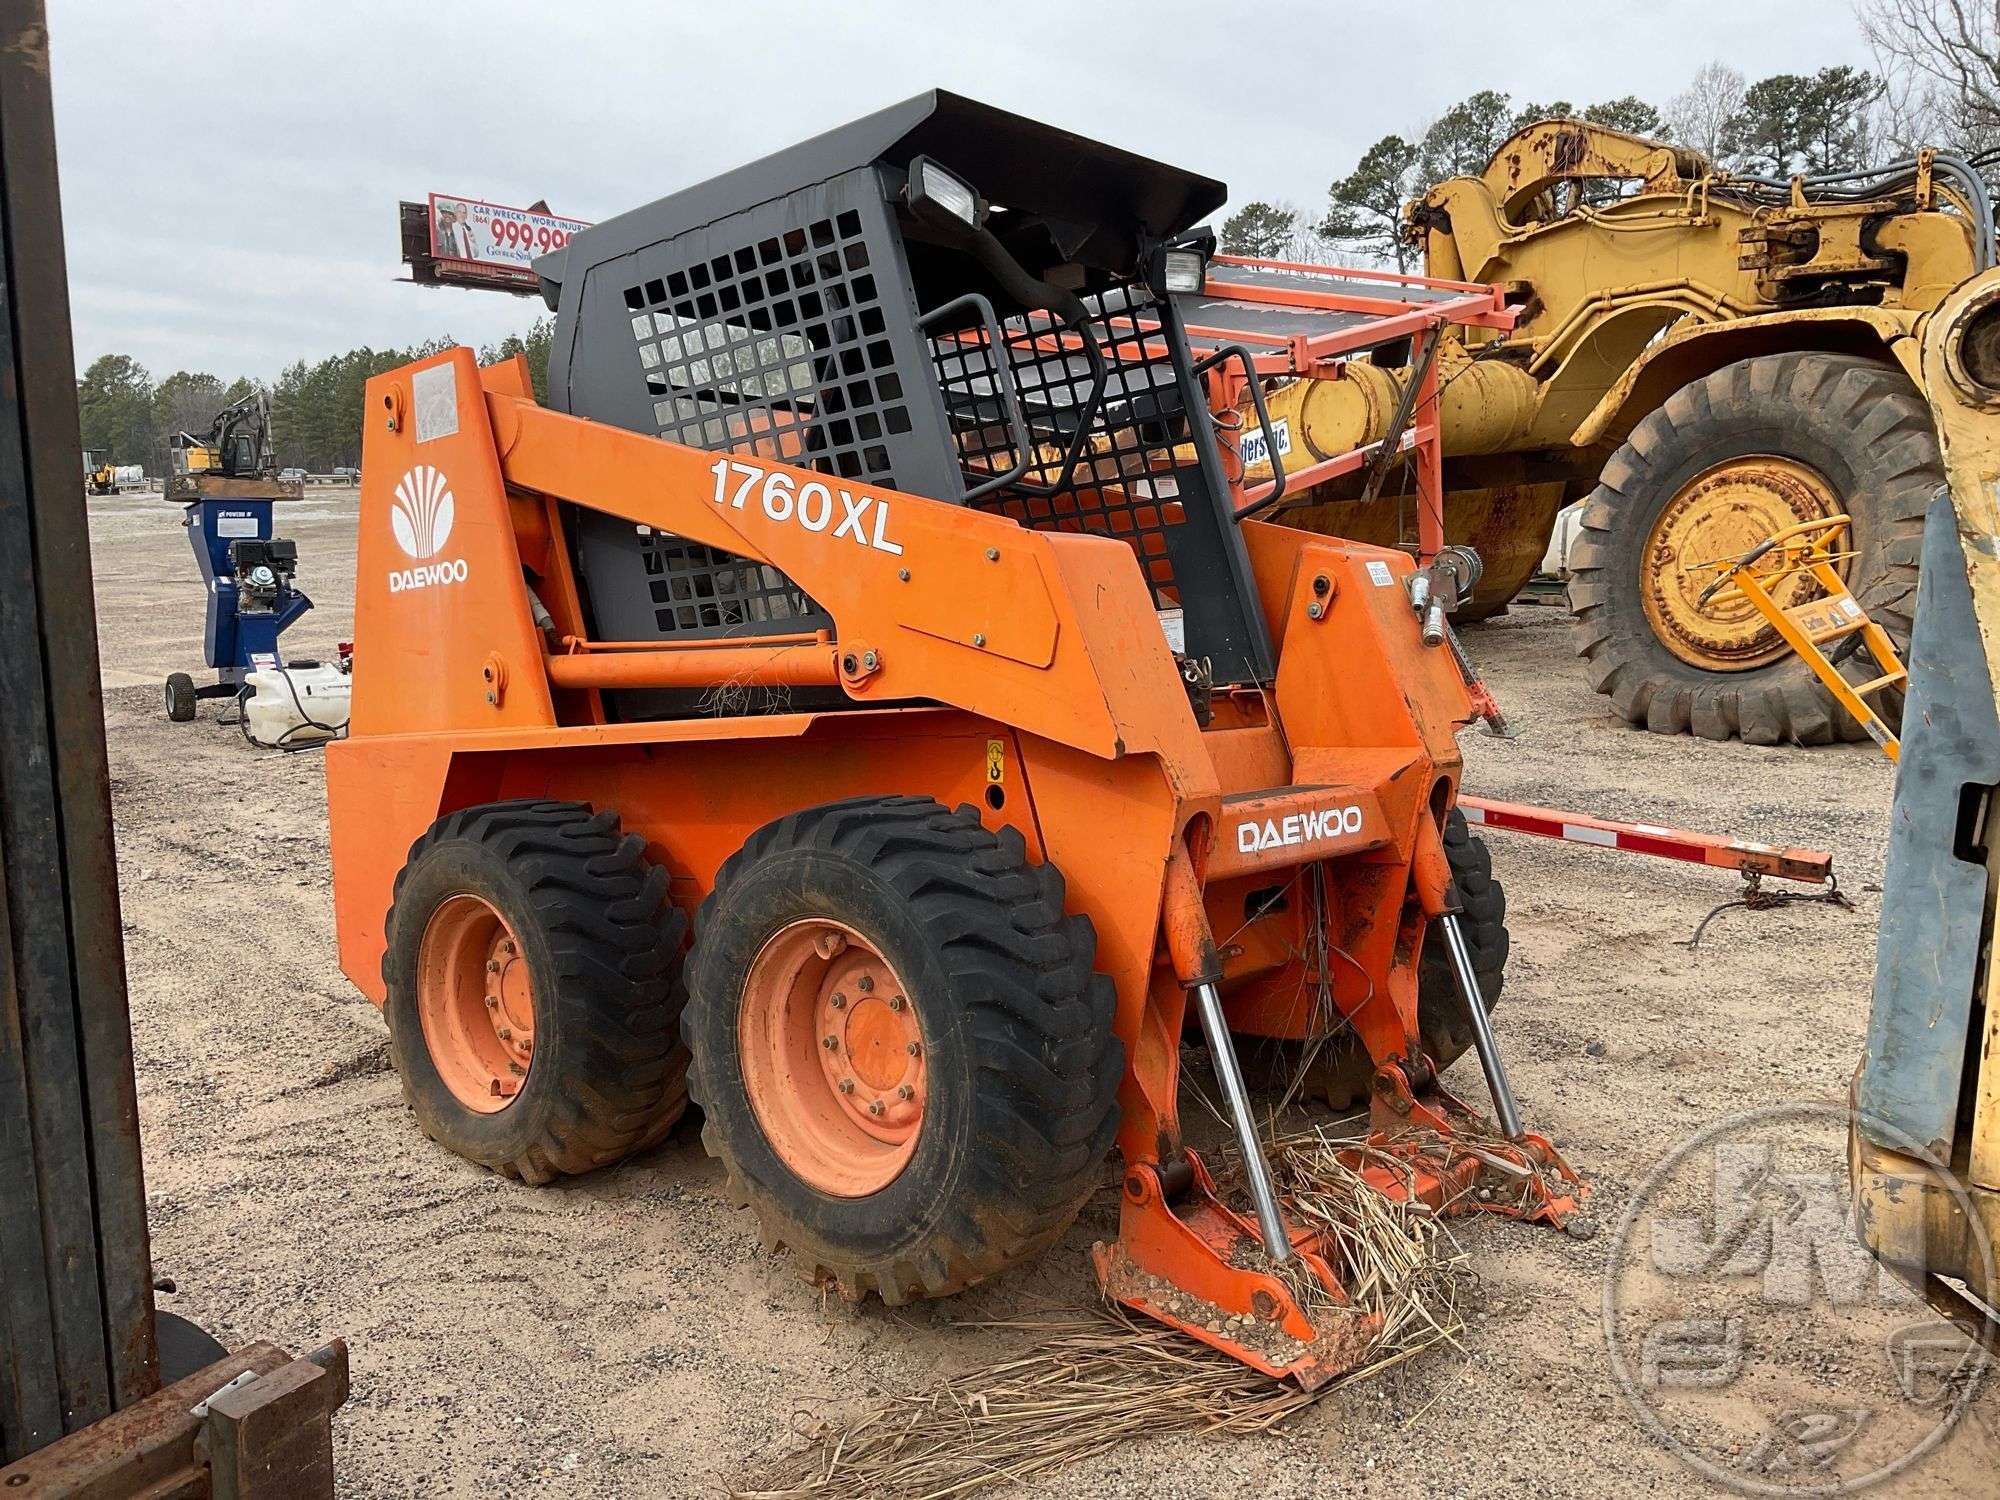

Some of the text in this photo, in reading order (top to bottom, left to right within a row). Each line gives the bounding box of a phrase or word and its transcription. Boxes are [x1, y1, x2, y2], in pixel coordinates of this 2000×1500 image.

[473, 205, 490, 215] CAR
[493, 208, 526, 222] WRECK?
[531, 216, 557, 227] WORK
[710, 458, 904, 556] 1760XL
[389, 559, 468, 592] DAEWOO
[1237, 805, 1362, 853] DAEWOO
